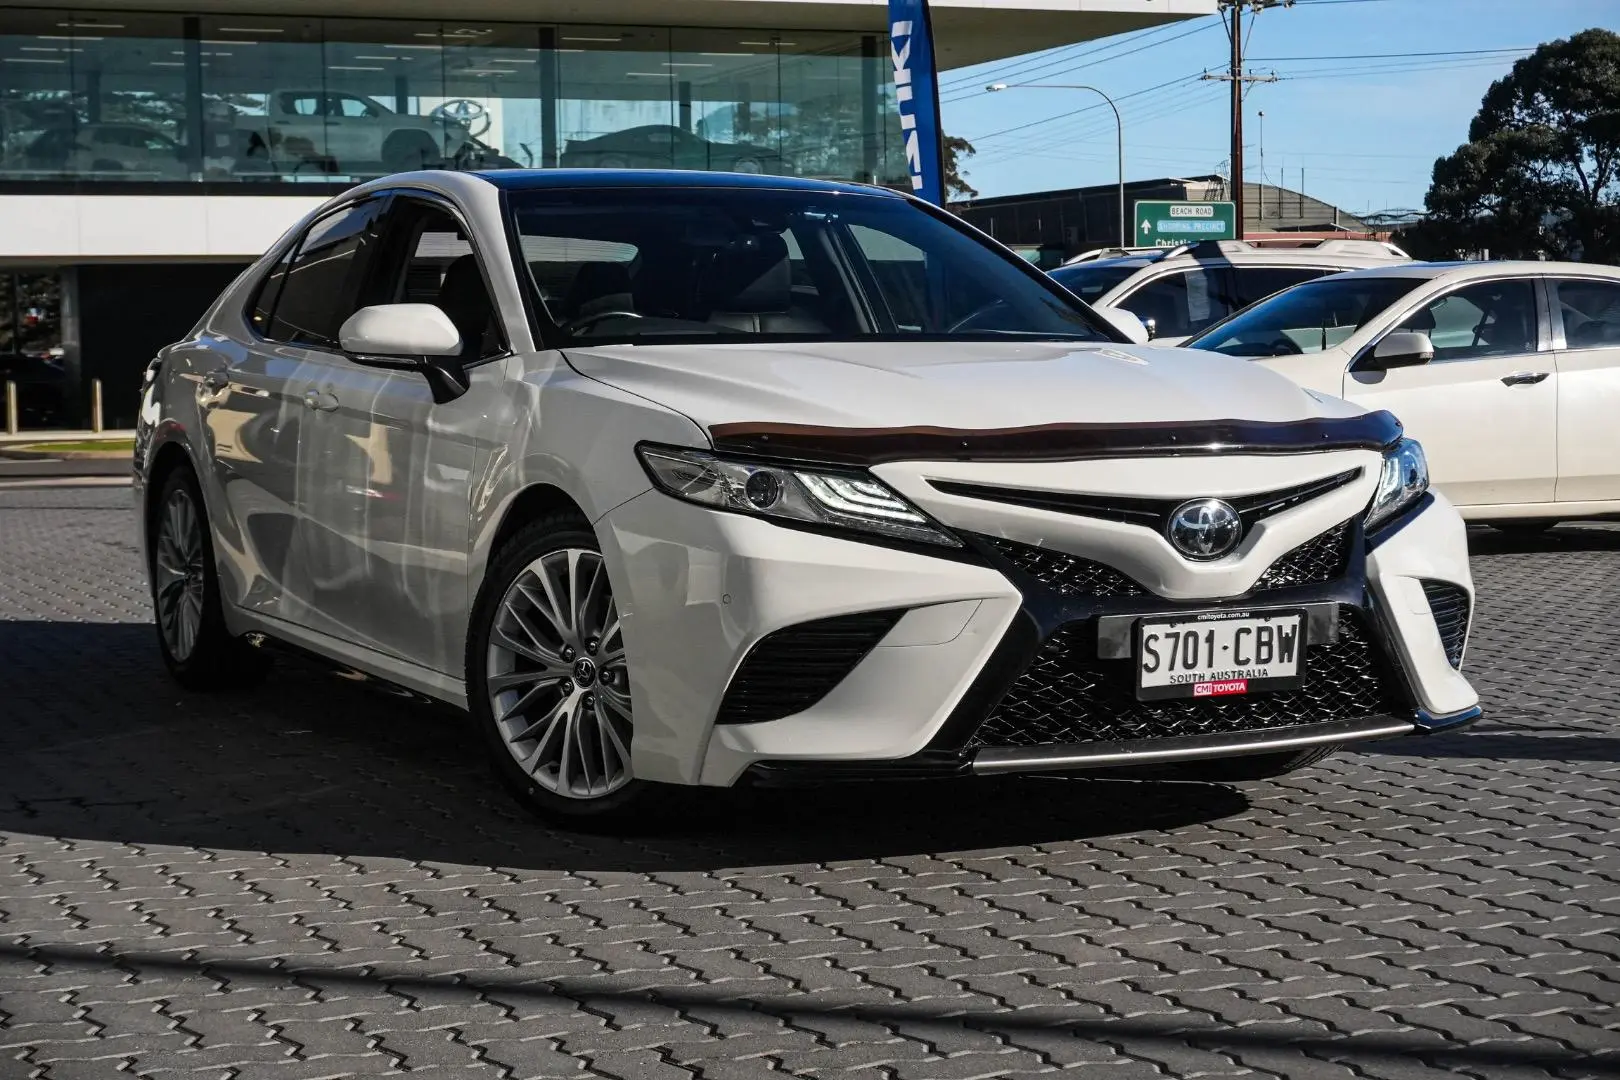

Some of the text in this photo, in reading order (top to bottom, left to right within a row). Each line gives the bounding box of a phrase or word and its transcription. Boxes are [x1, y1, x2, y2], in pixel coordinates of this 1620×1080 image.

[1172, 206, 1212, 215] BEACH ROAD
[1197, 612, 1250, 620] cmitoyota.com.au
[1169, 668, 1269, 684] SOUTH AUSTRALIA
[1213, 682, 1246, 693] TOYOTA
